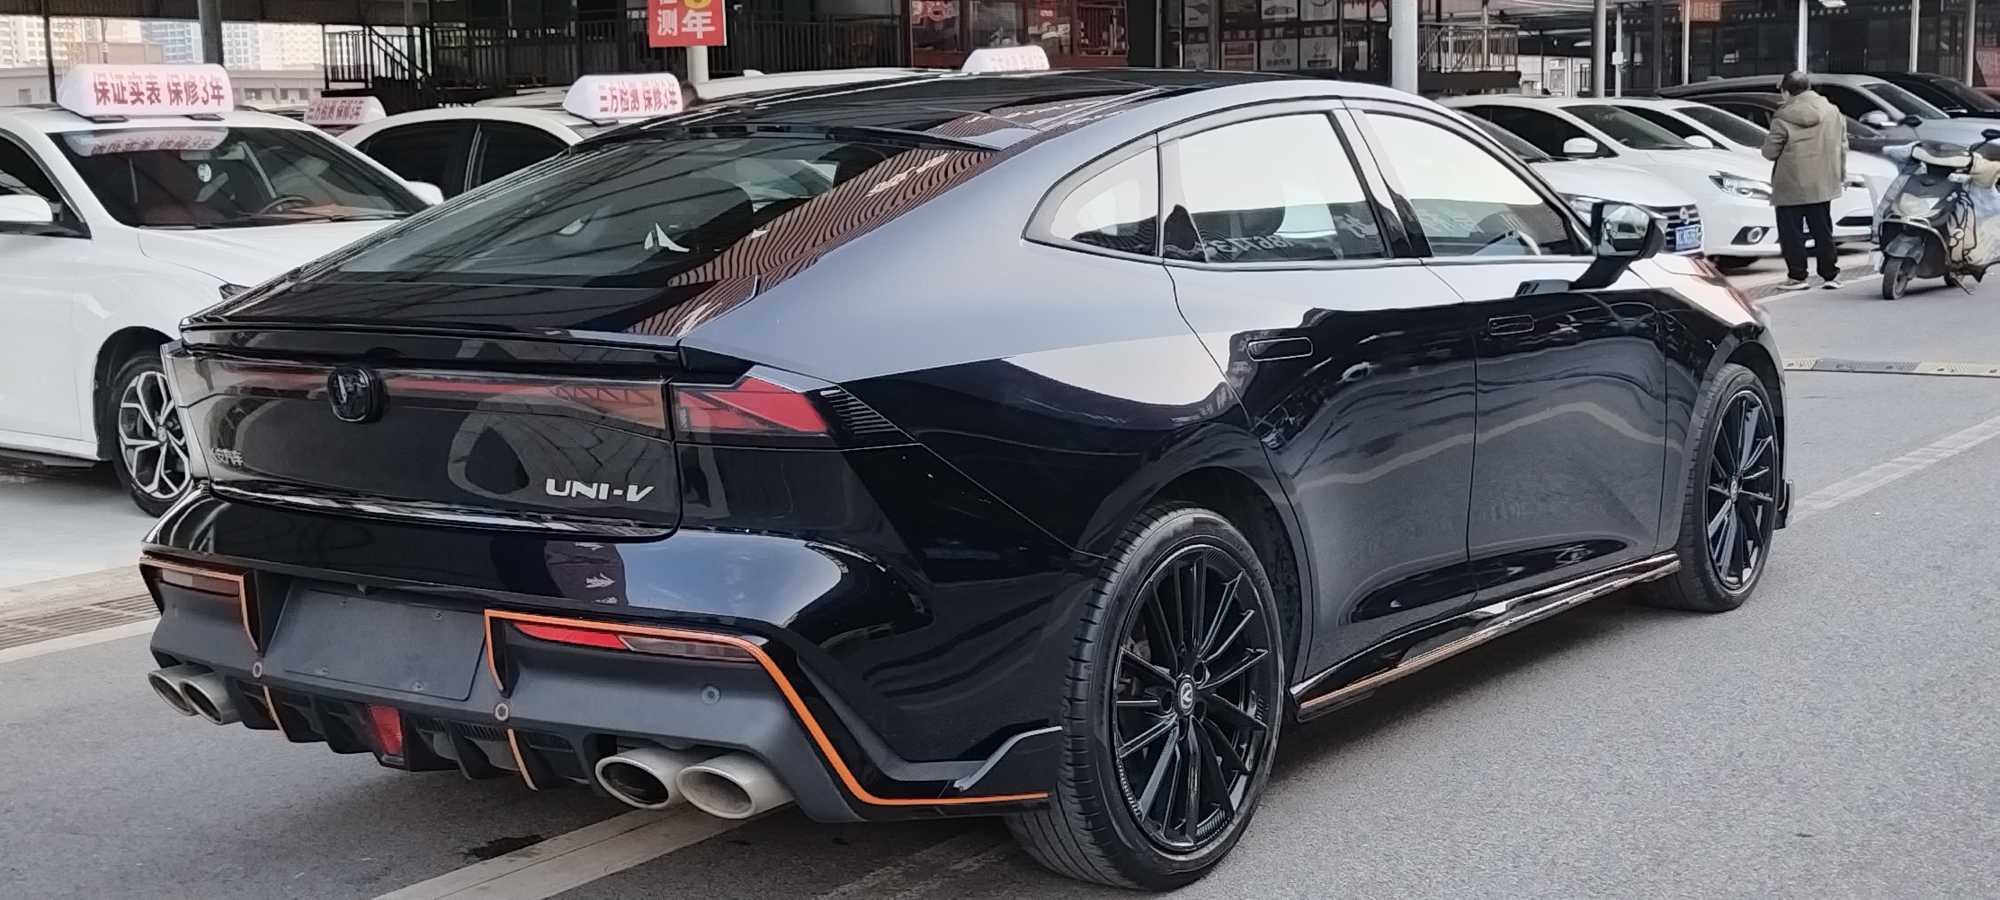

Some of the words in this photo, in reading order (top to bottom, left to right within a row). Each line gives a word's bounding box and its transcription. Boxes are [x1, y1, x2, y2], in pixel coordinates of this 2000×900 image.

[657, 0, 678, 36] 测
[681, 0, 716, 39] 年
[94, 73, 162, 105] 保证实表
[167, 73, 225, 106] 保修3年
[545, 478, 655, 502] UNI-V
